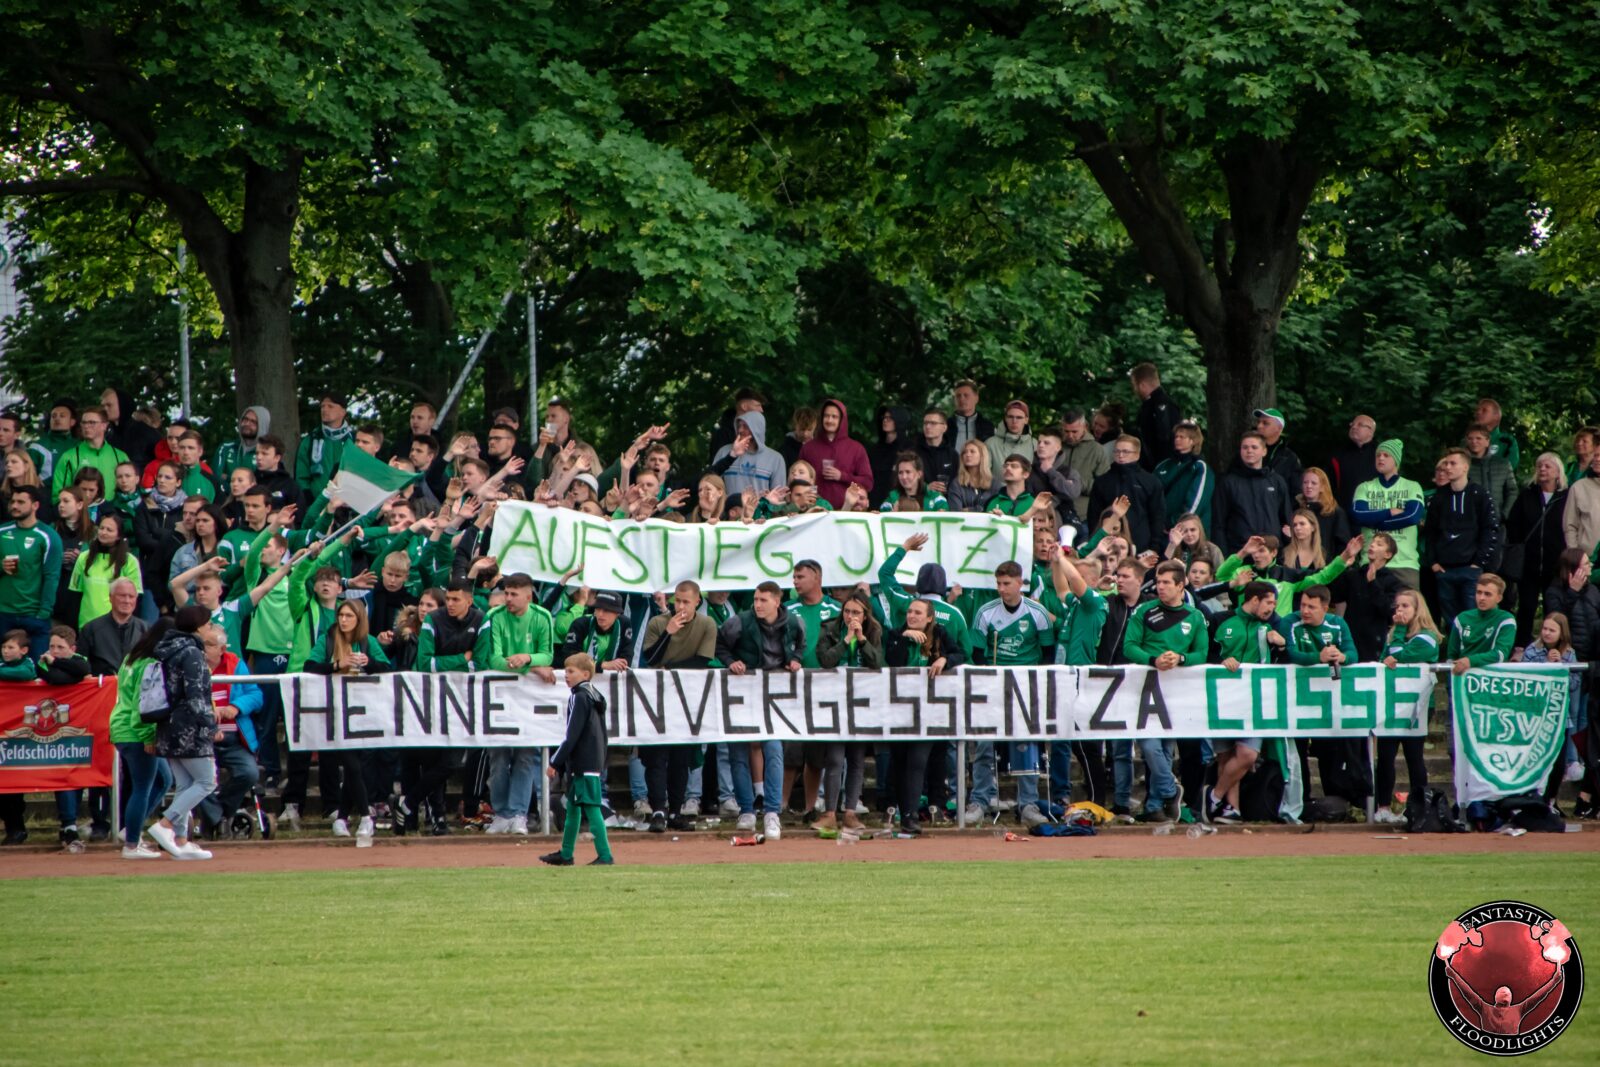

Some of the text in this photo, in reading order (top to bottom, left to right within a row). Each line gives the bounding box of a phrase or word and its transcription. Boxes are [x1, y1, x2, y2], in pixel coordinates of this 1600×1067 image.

[497, 508, 1029, 584] AUFSTIEG JETZT
[1088, 668, 1172, 729] ZA
[1205, 667, 1421, 729] COSSE
[1467, 675, 1549, 697] DRESDEN
[1471, 703, 1541, 743] TSV
